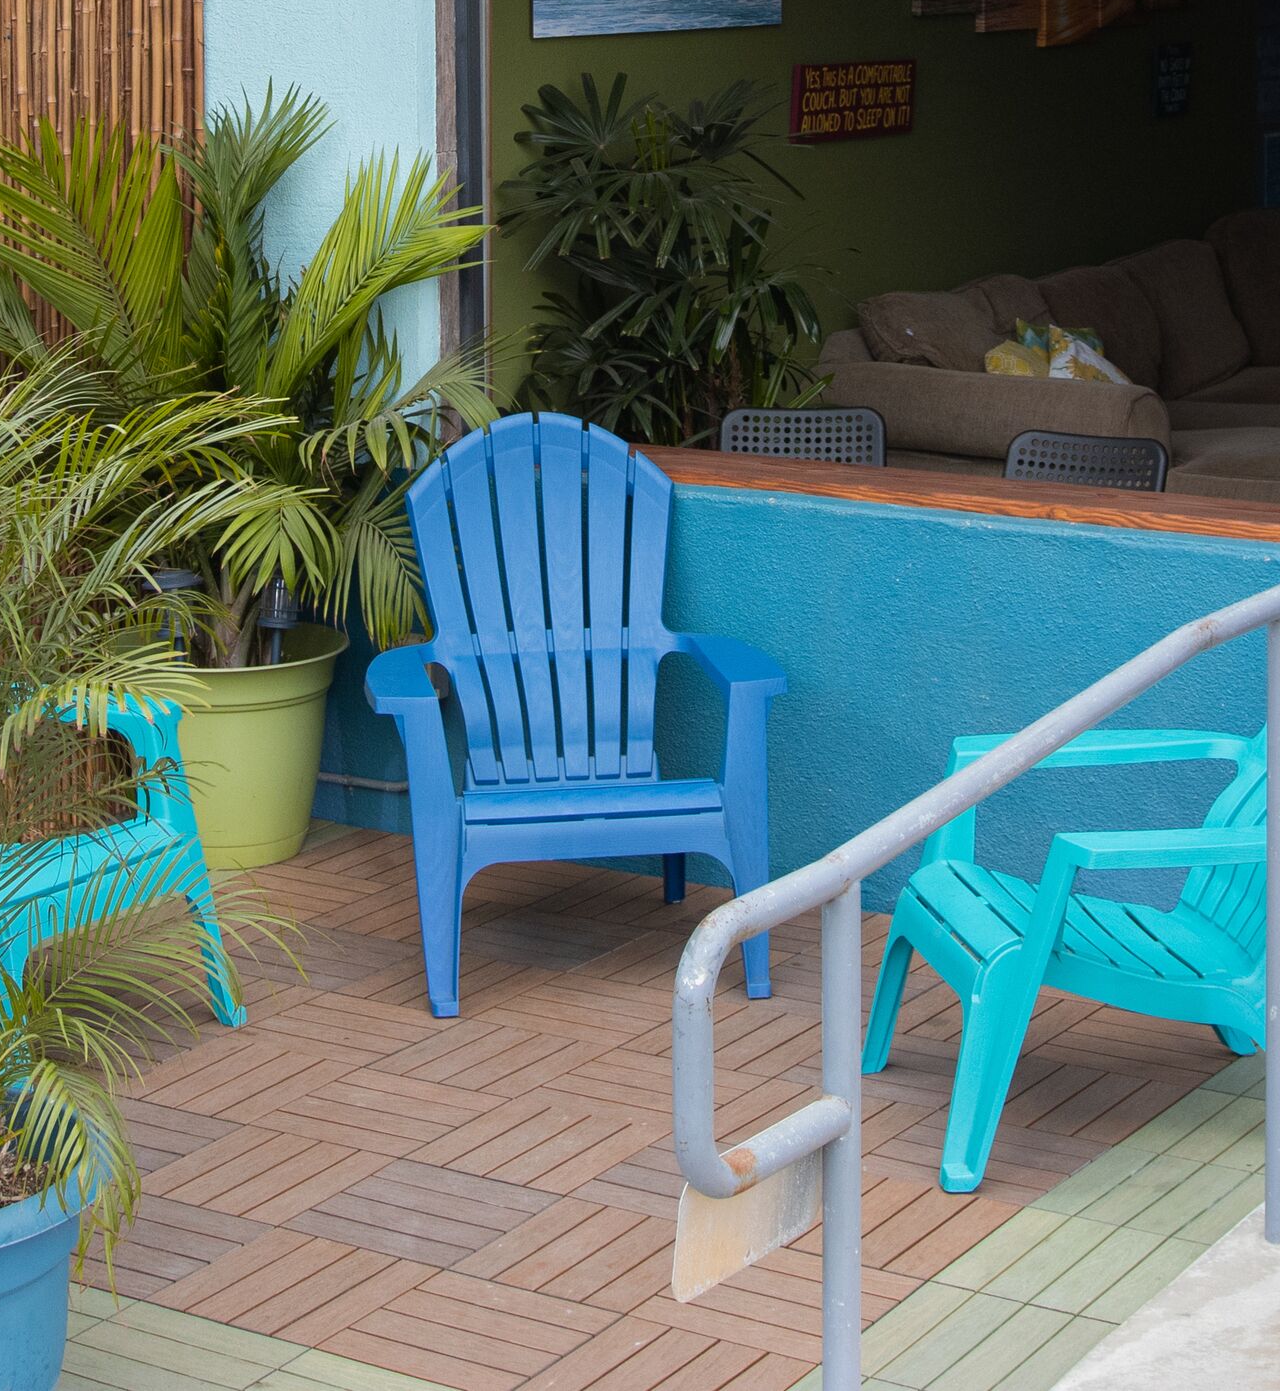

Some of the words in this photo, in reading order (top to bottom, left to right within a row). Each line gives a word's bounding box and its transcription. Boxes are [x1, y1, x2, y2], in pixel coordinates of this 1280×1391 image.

[855, 63, 913, 84] COMFORTABLE
[839, 88, 858, 108] BUT
[860, 86, 874, 106] YOU
[878, 86, 892, 104] ARE
[895, 84, 911, 104] NOT
[801, 113, 841, 133] ALLOWED
[843, 111, 854, 131] TO
[856, 107, 882, 130] SLEEP
[883, 107, 895, 128] ON
